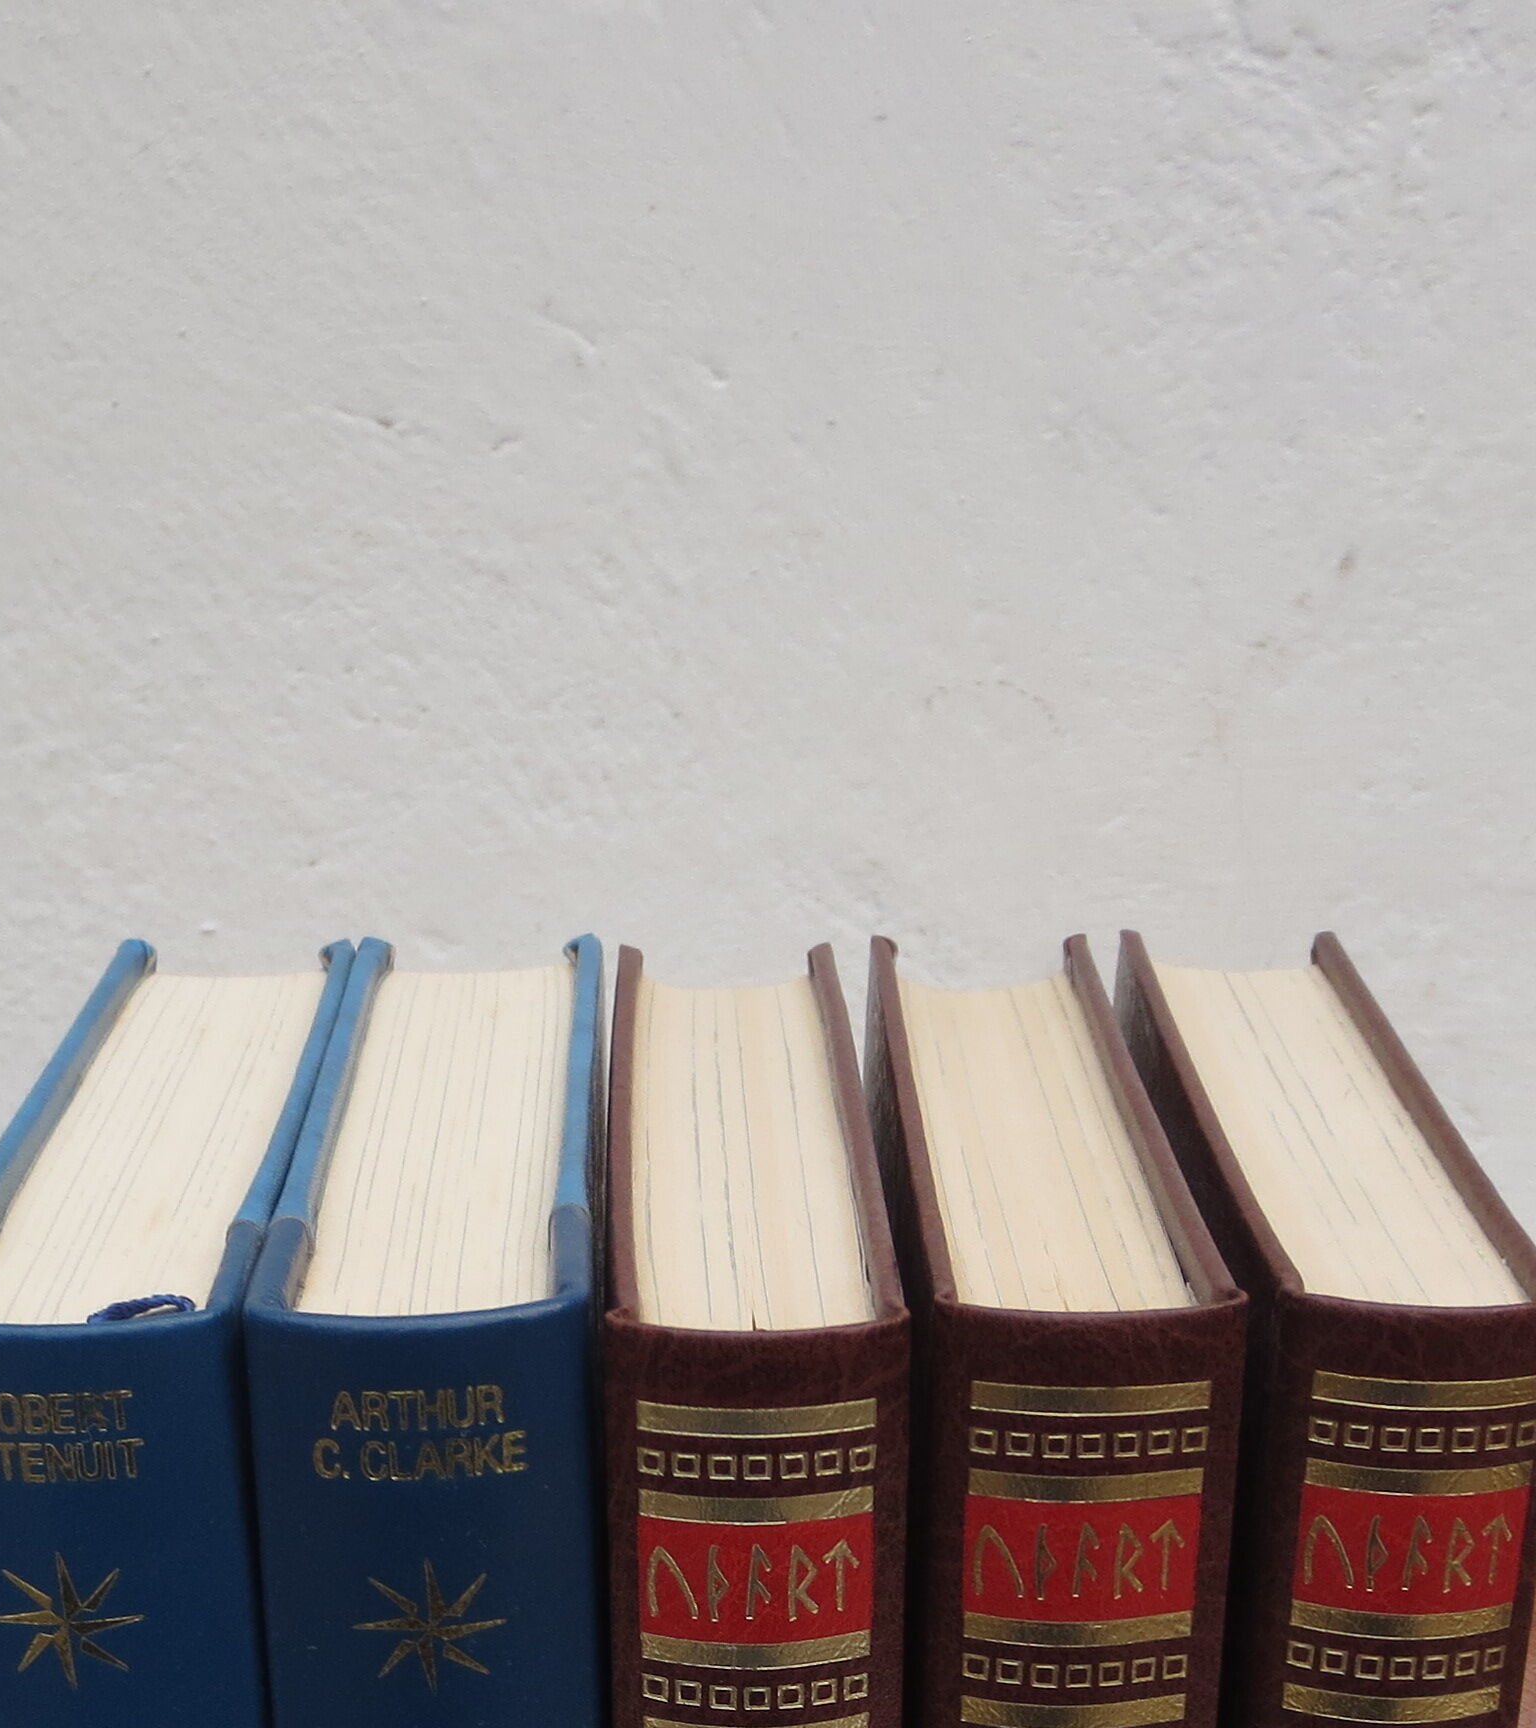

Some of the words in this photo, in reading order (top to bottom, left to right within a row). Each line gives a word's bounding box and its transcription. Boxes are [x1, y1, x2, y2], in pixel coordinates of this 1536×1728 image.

[330, 1384, 505, 1432] ARTHUR
[313, 1438, 350, 1480] C.
[360, 1430, 528, 1481] CLARKE
